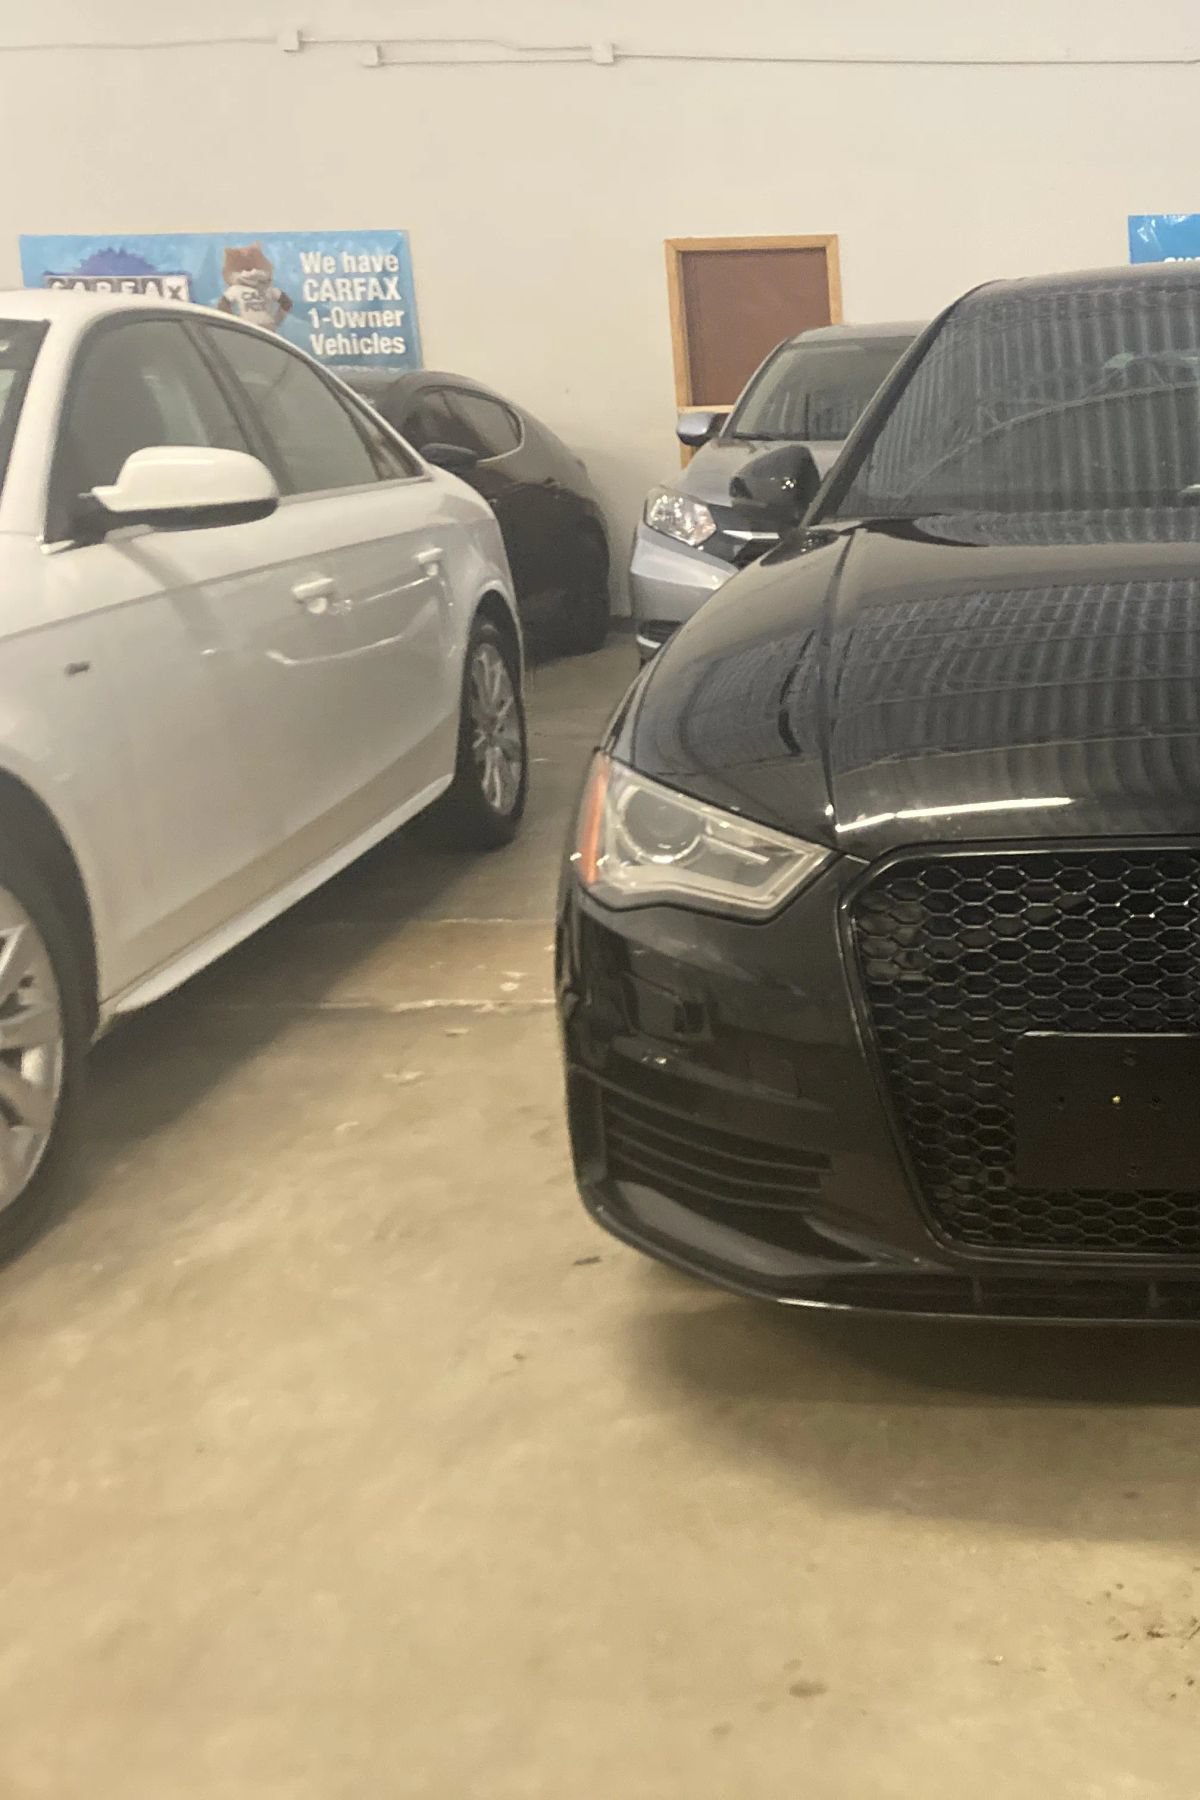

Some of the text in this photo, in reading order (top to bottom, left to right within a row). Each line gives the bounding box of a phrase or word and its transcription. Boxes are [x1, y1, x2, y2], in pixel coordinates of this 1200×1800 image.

[300, 251, 399, 274] We have
[302, 277, 402, 303] CARFAX
[308, 307, 404, 329] 1-Owner
[309, 333, 407, 356] Vehicles
